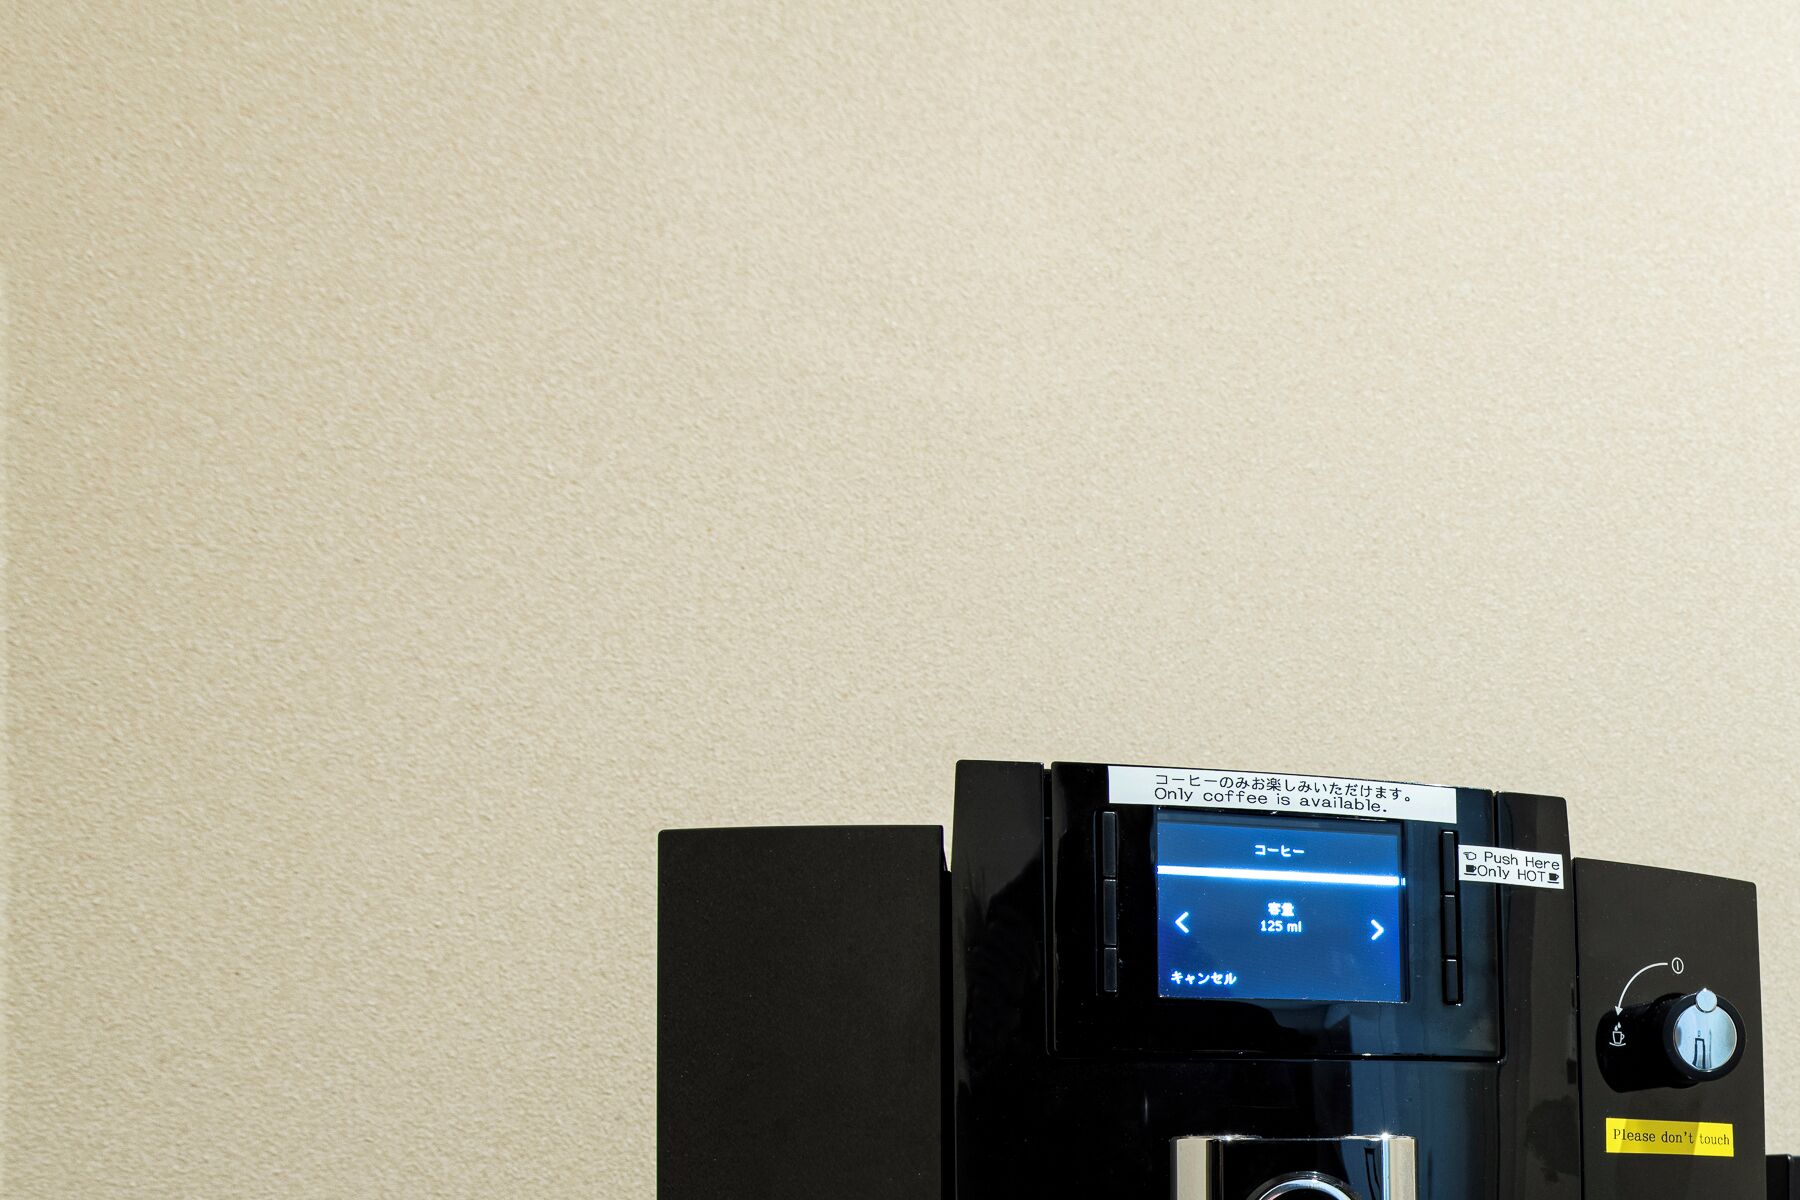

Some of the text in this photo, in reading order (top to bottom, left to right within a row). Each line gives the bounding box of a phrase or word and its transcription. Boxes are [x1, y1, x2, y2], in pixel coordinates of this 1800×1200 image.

[1155, 774, 1411, 802] コーヒーのみお楽しみいただけます。
[1154, 787, 1387, 812] Only coffee is available.
[1254, 844, 1305, 857] コーヒー
[1484, 851, 1560, 870] Push Here
[1477, 865, 1545, 882] Only HOT
[1260, 920, 1302, 933] 125 ml
[1170, 970, 1237, 985] キャンセル
[1613, 1128, 1730, 1145] Please don't touch
